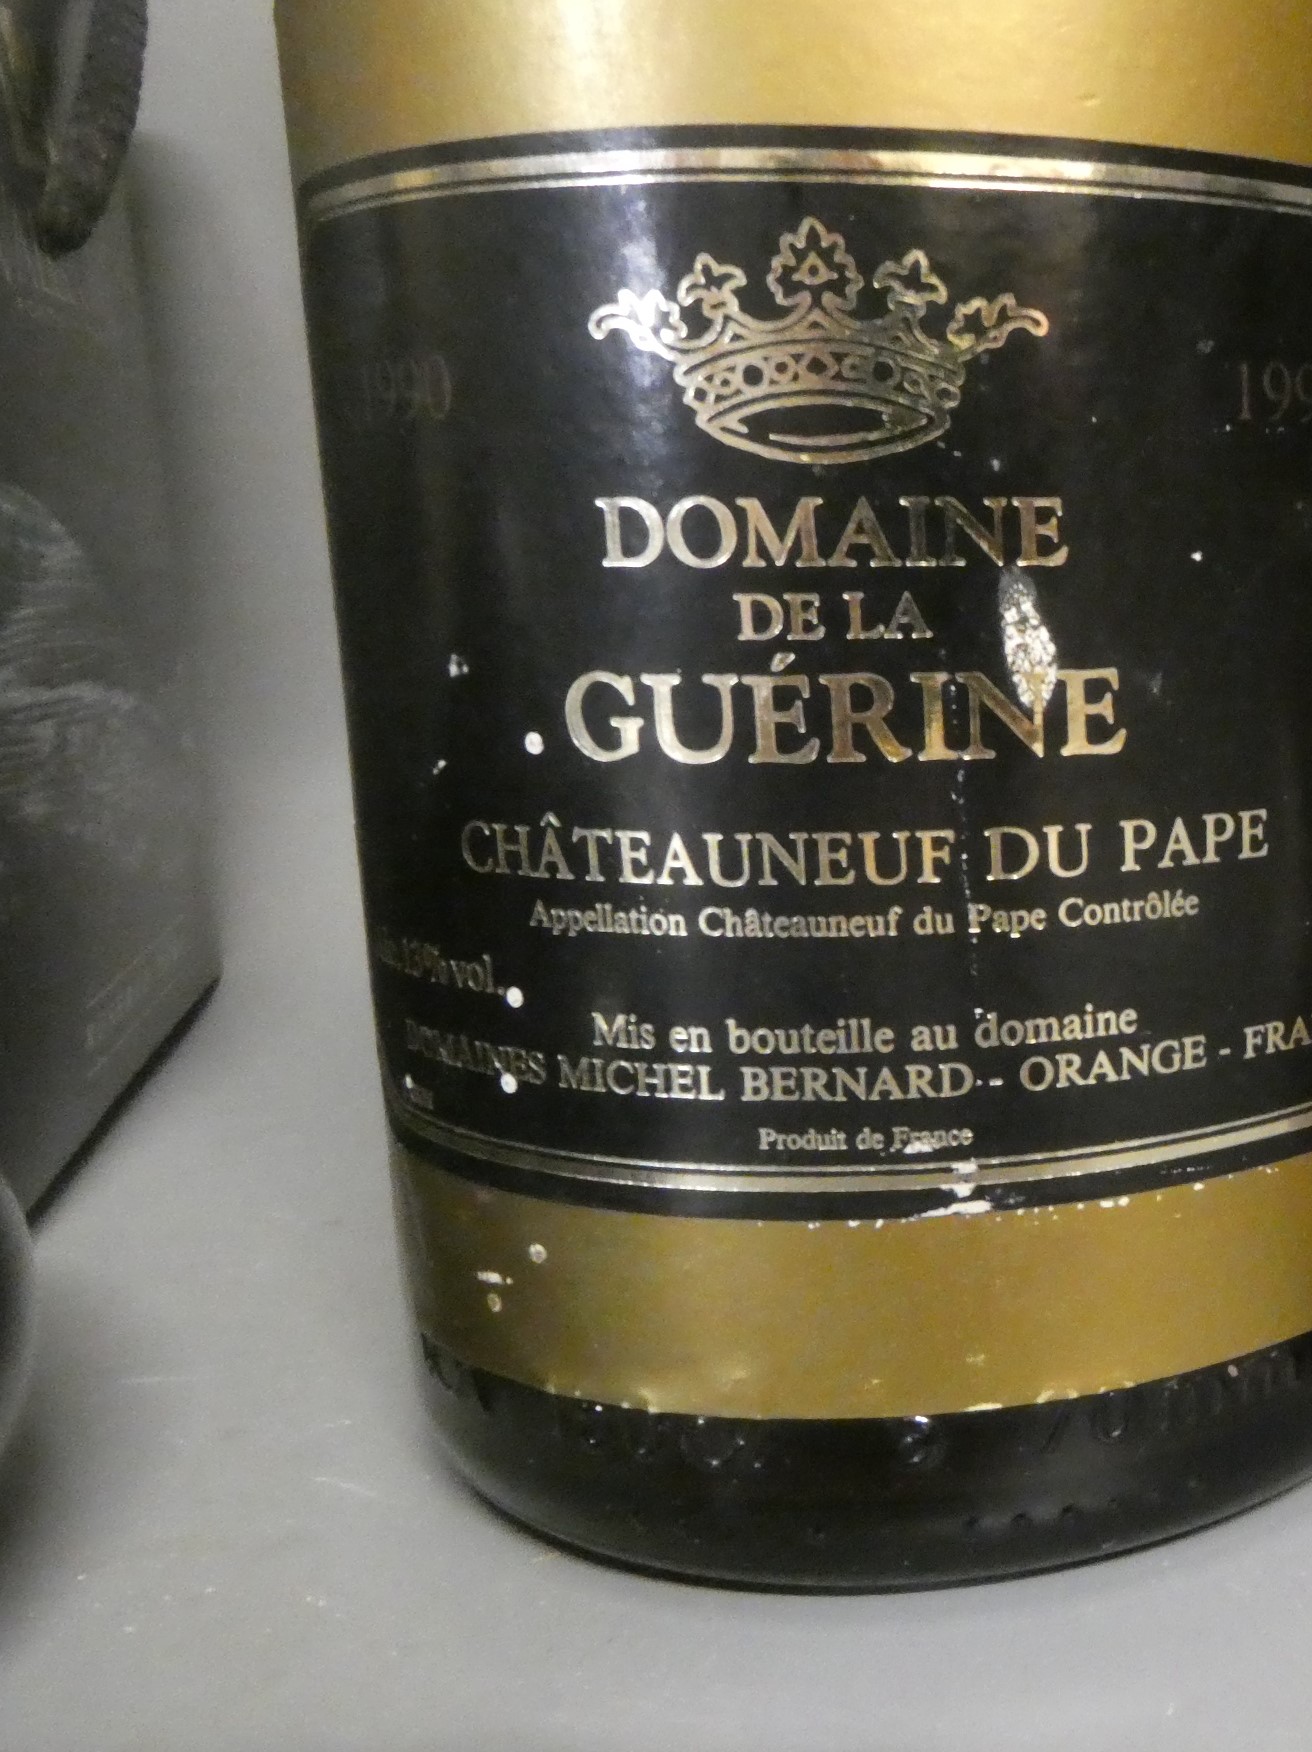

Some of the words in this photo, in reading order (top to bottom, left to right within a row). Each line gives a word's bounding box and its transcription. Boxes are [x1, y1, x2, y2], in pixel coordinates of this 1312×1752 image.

[595, 494, 1069, 569] DOMAINE
[733, 591, 826, 641] DE
[843, 590, 933, 640] LA
[564, 653, 1127, 765] GUÉRINE
[460, 811, 955, 888] CHÂTEAUNEUF
[984, 823, 1092, 879] DU
[1119, 808, 1269, 872] PAPE
[529, 899, 688, 937] Appellation
[699, 905, 903, 938] Châteauneuf
[913, 906, 955, 934] du
[968, 903, 1047, 938] Pape
[1058, 889, 1200, 927] Contrôlée
[592, 1011, 656, 1050] Mis
[669, 1024, 713, 1054] en
[726, 1018, 895, 1054] bouteille
[911, 1024, 958, 1051] au
[975, 1003, 1138, 1049] domaine
[557, 1054, 725, 1101] MICHEL
[1020, 1035, 1207, 1091] ORANGE
[758, 1127, 847, 1150] Produit
[855, 1127, 884, 1150] de
[890, 1126, 974, 1152] France
